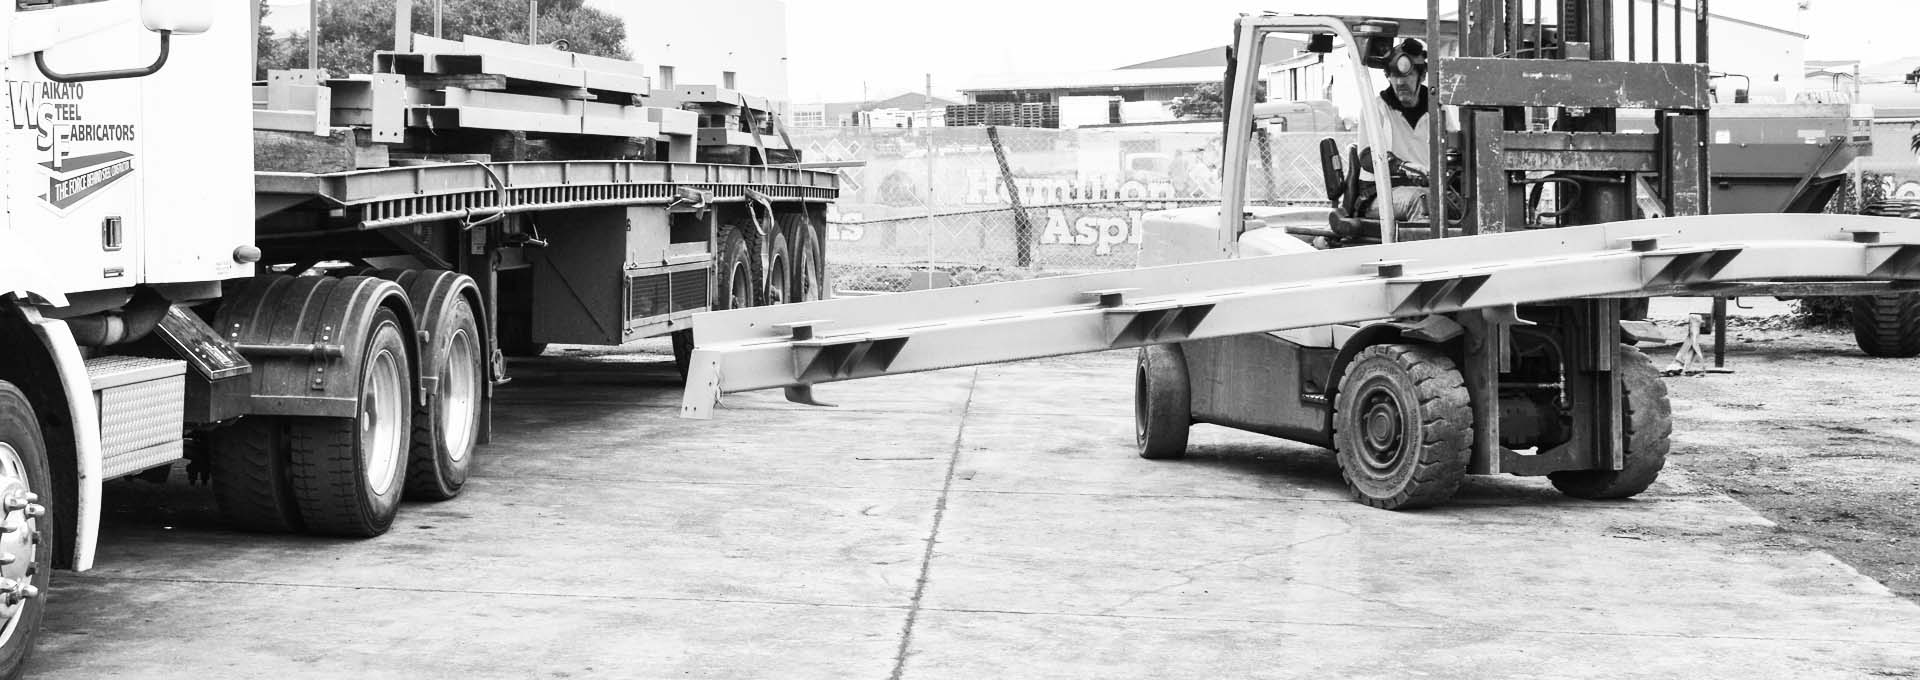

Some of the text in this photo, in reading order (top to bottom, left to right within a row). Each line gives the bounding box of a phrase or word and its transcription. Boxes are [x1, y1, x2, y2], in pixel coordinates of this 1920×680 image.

[9, 81, 84, 129] WAIKATO
[37, 102, 82, 151] STEEL
[52, 124, 135, 171] FABRICATORS
[55, 181, 69, 201] THE
[69, 174, 87, 195] FORCE
